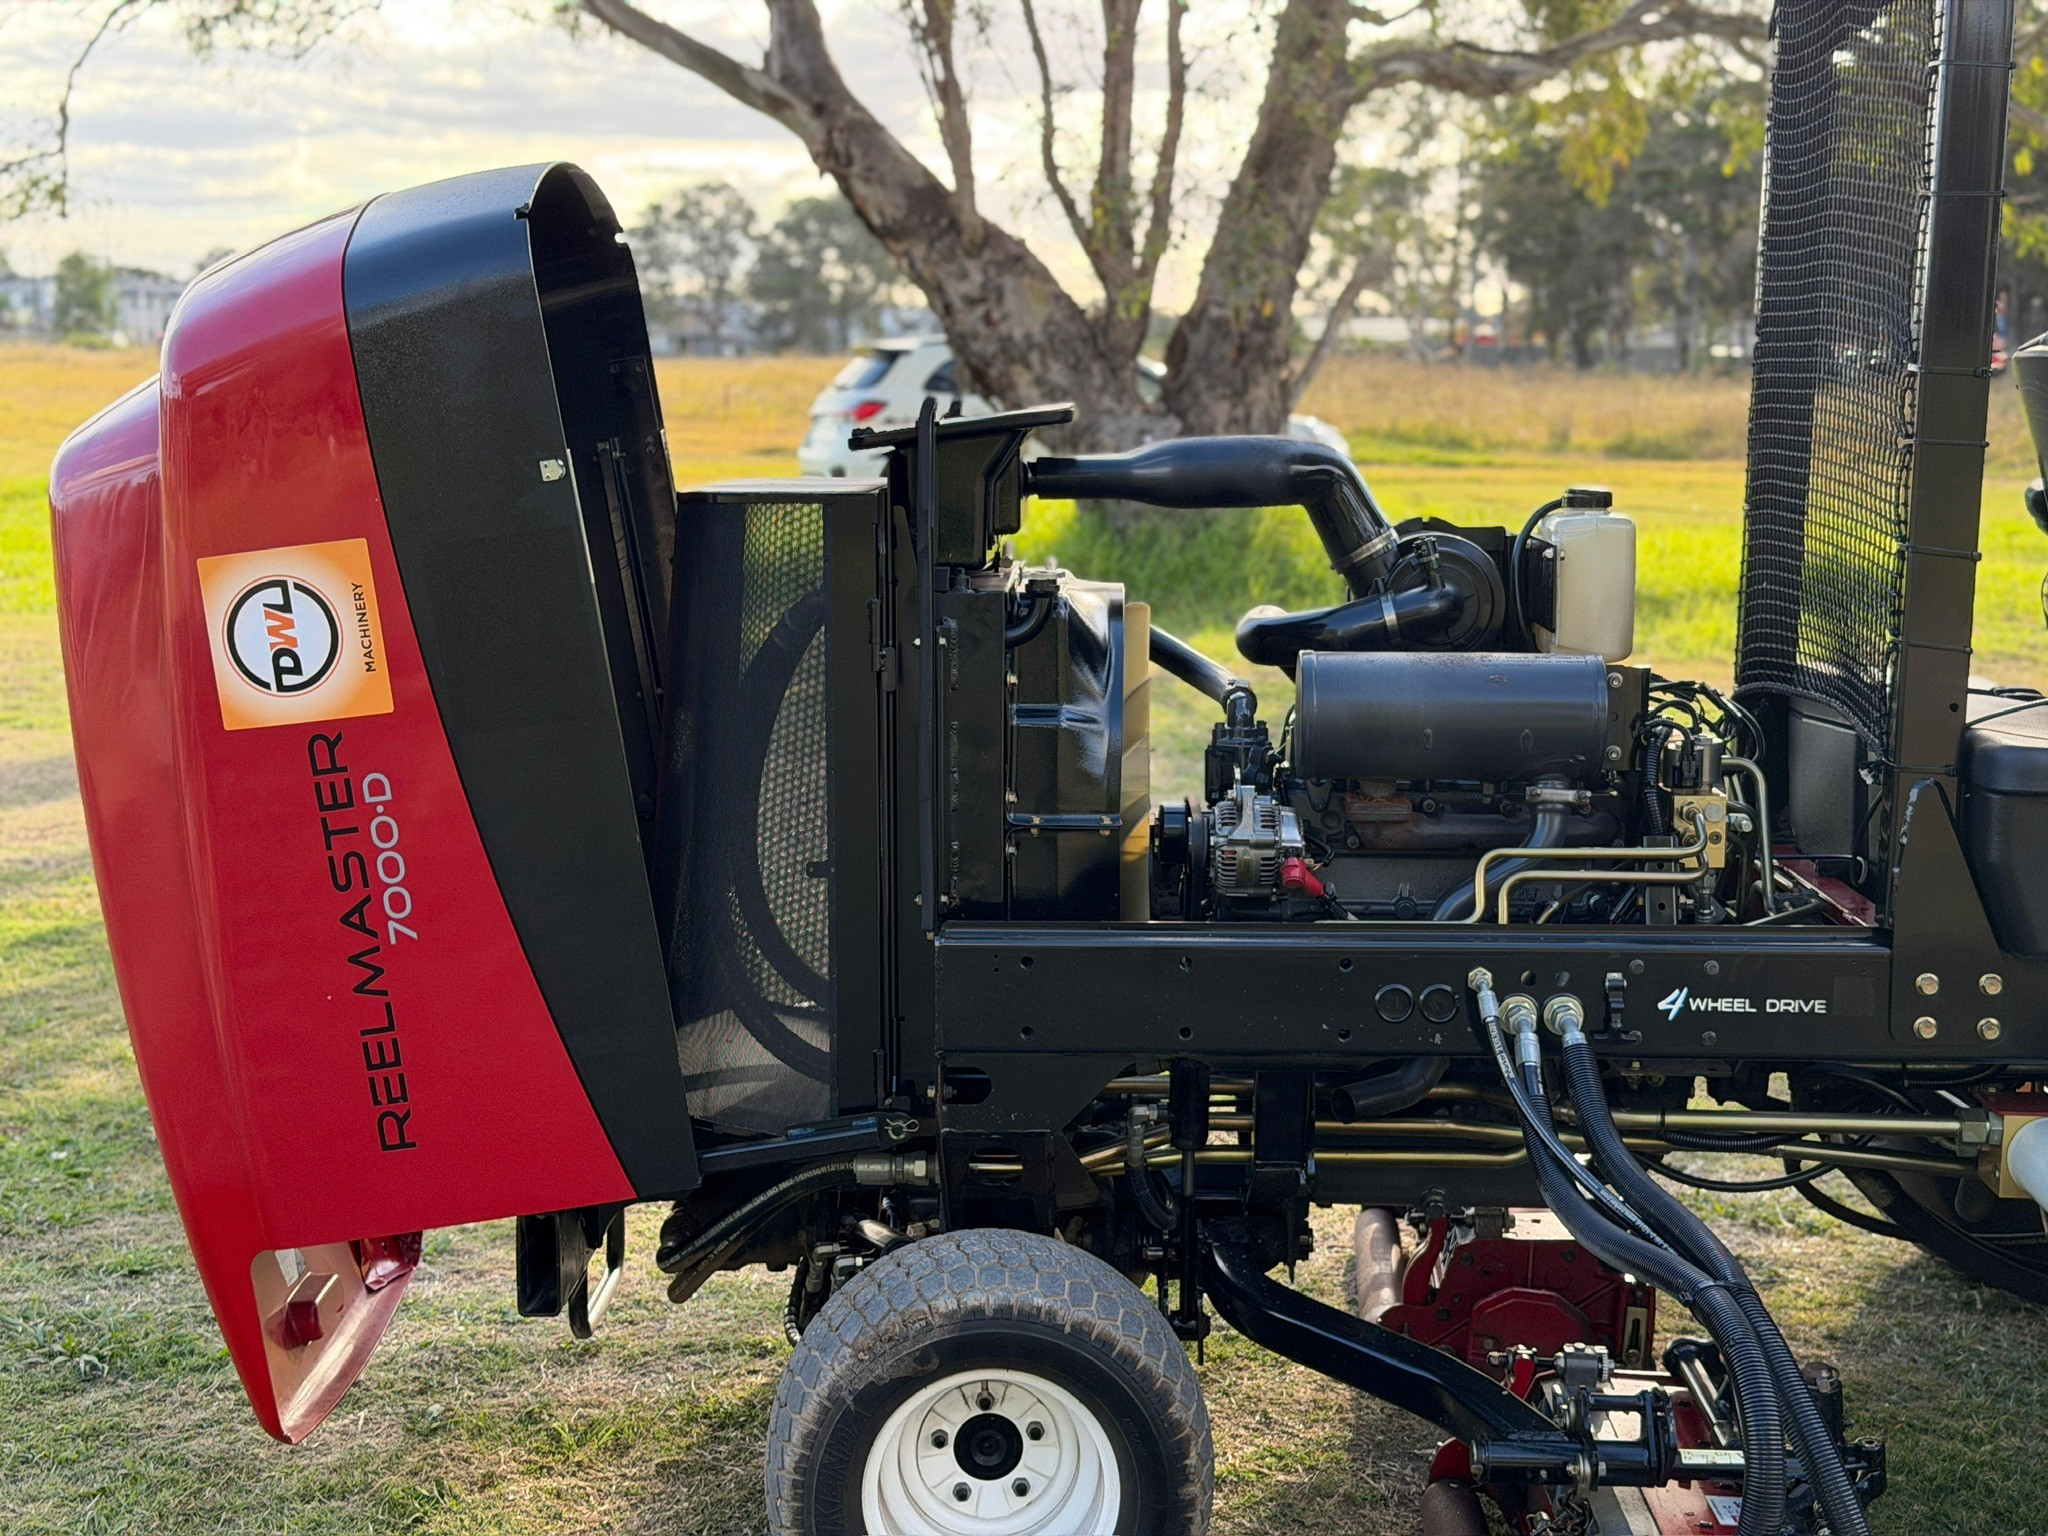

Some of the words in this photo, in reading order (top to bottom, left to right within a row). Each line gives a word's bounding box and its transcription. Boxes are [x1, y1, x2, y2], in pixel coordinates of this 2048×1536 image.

[262, 579, 304, 692] DWL
[351, 582, 377, 673] MACHINERY
[308, 730, 418, 1152] REELMASTER
[1657, 986, 1689, 1022] 4
[1689, 998, 1757, 1013] WHEEL
[1766, 999, 1827, 1014] DRIVE
